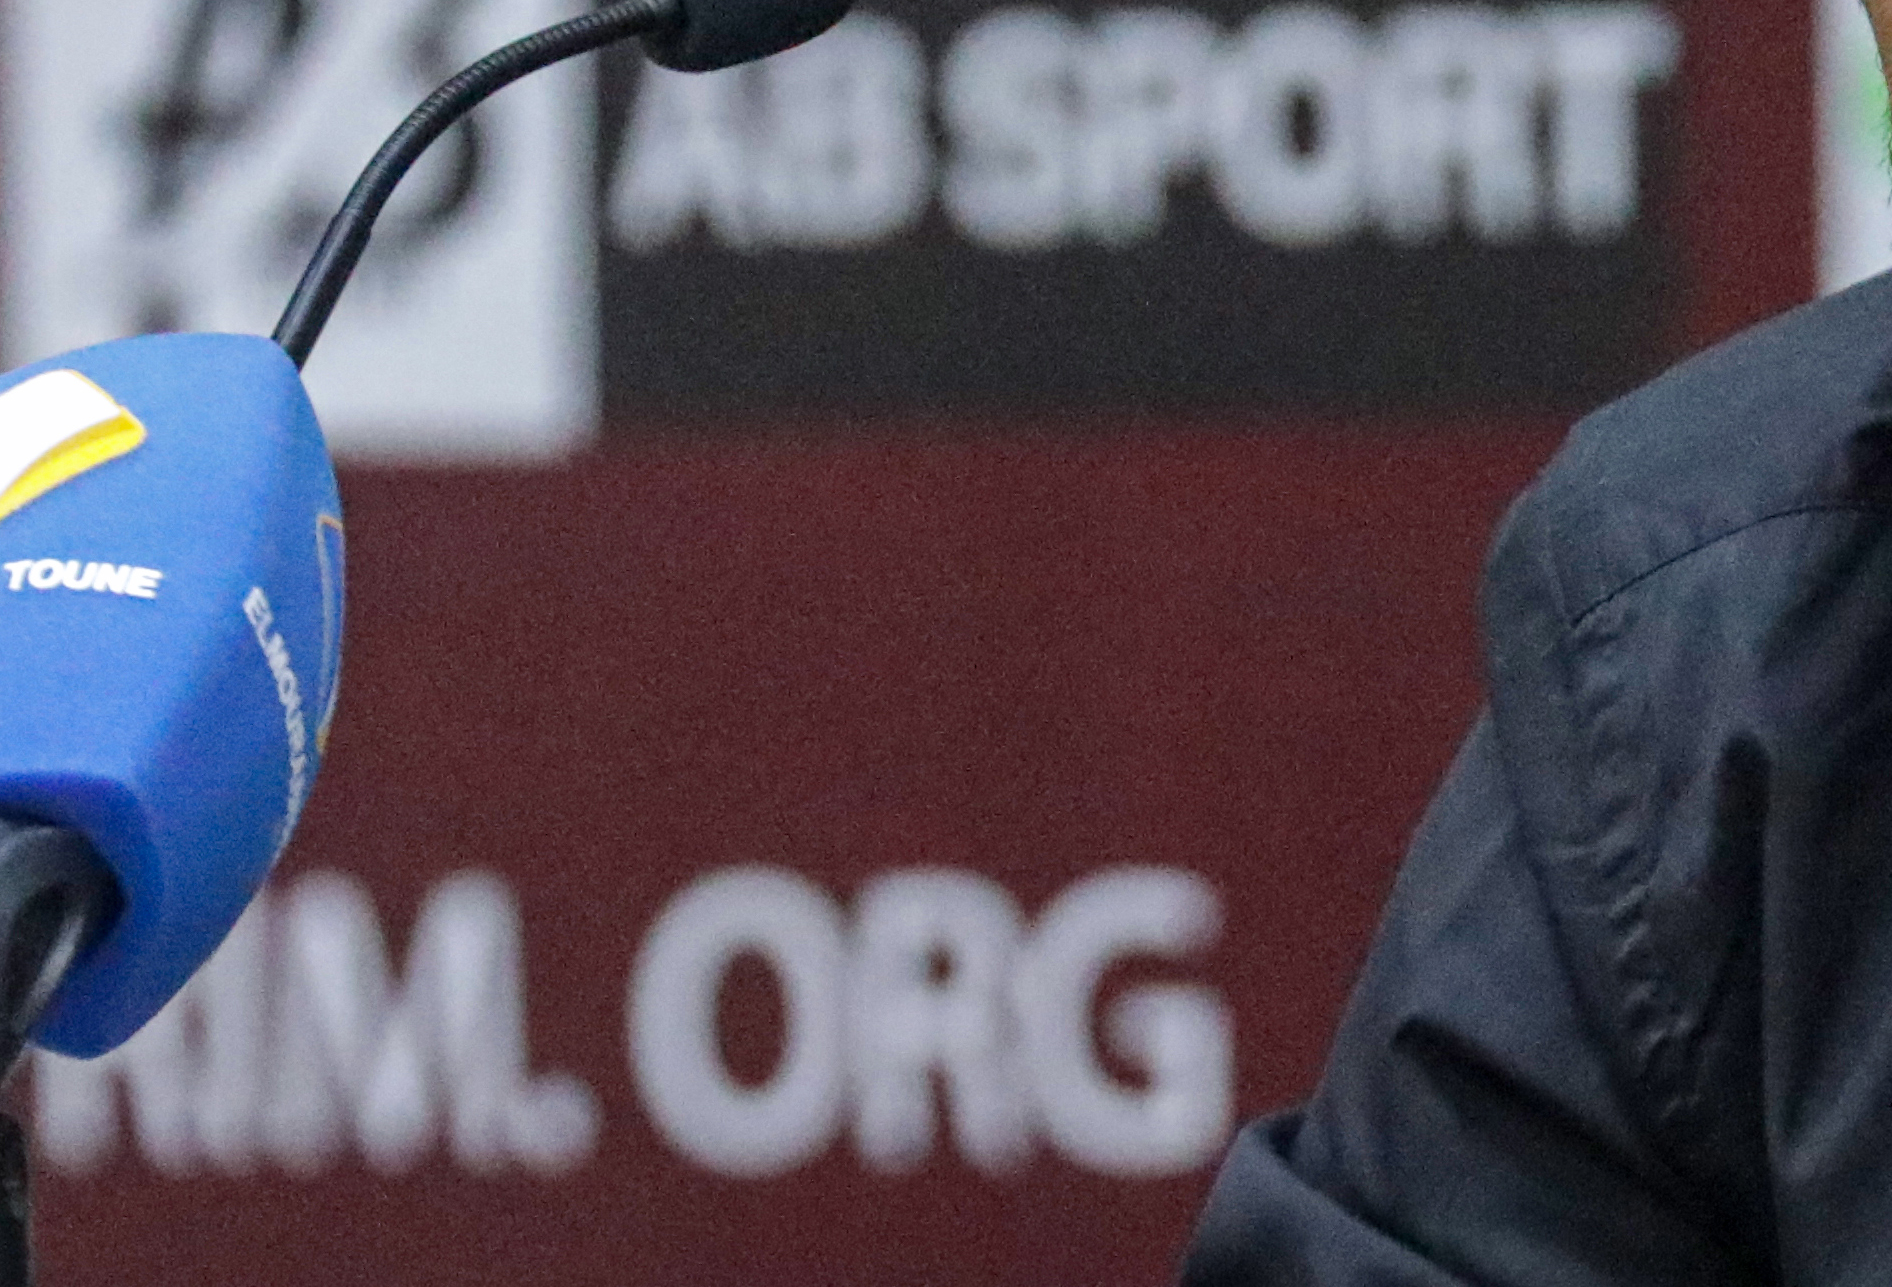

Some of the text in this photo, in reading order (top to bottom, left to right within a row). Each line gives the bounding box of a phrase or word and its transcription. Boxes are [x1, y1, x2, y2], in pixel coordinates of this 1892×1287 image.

[608, 12, 930, 251] AB
[940, 5, 1681, 247] SPORT
[4, 558, 163, 599] TOUNE
[631, 866, 1234, 1177] ORG
